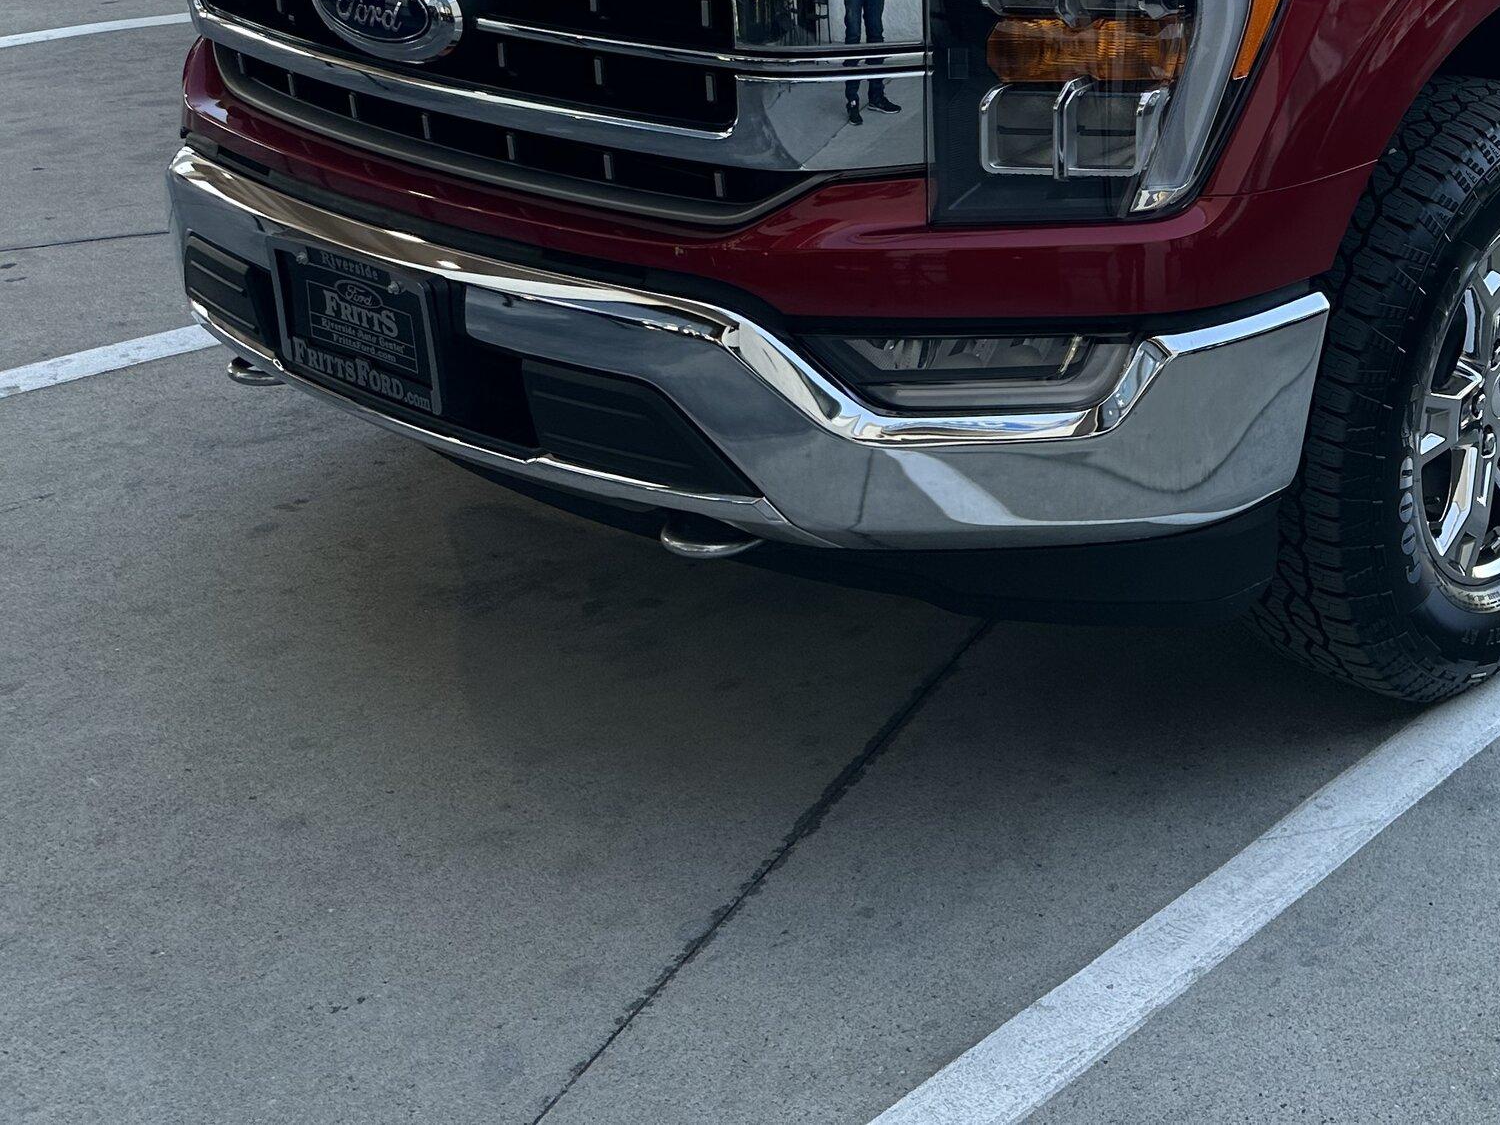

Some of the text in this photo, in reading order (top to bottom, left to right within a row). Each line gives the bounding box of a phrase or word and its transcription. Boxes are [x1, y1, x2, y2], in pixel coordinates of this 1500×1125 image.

[320, 251, 379, 279] Riverside
[344, 284, 373, 307] Ford
[323, 289, 398, 338] FRITTS
